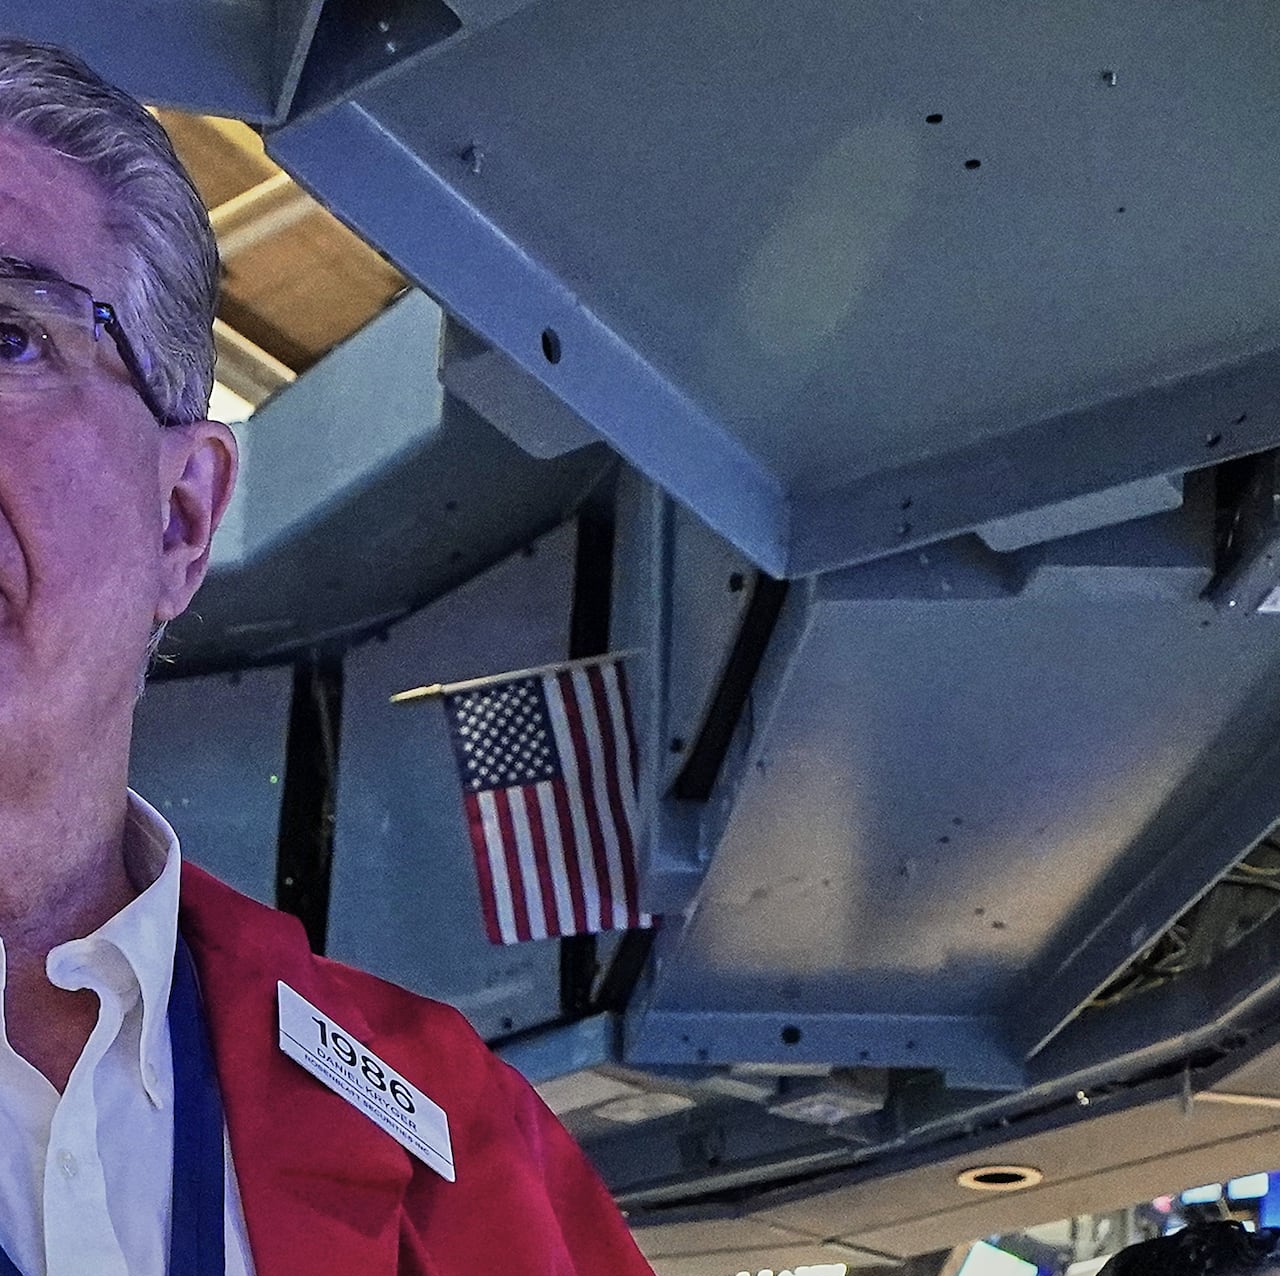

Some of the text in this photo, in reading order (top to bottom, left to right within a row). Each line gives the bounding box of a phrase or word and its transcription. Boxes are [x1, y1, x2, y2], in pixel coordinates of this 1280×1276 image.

[304, 1053, 361, 1101] ROSENBLATT
[362, 1099, 414, 1146] SECURITIES
[311, 1016, 416, 1114] 1986
[316, 1047, 418, 1134] DANIEL KRYGER
